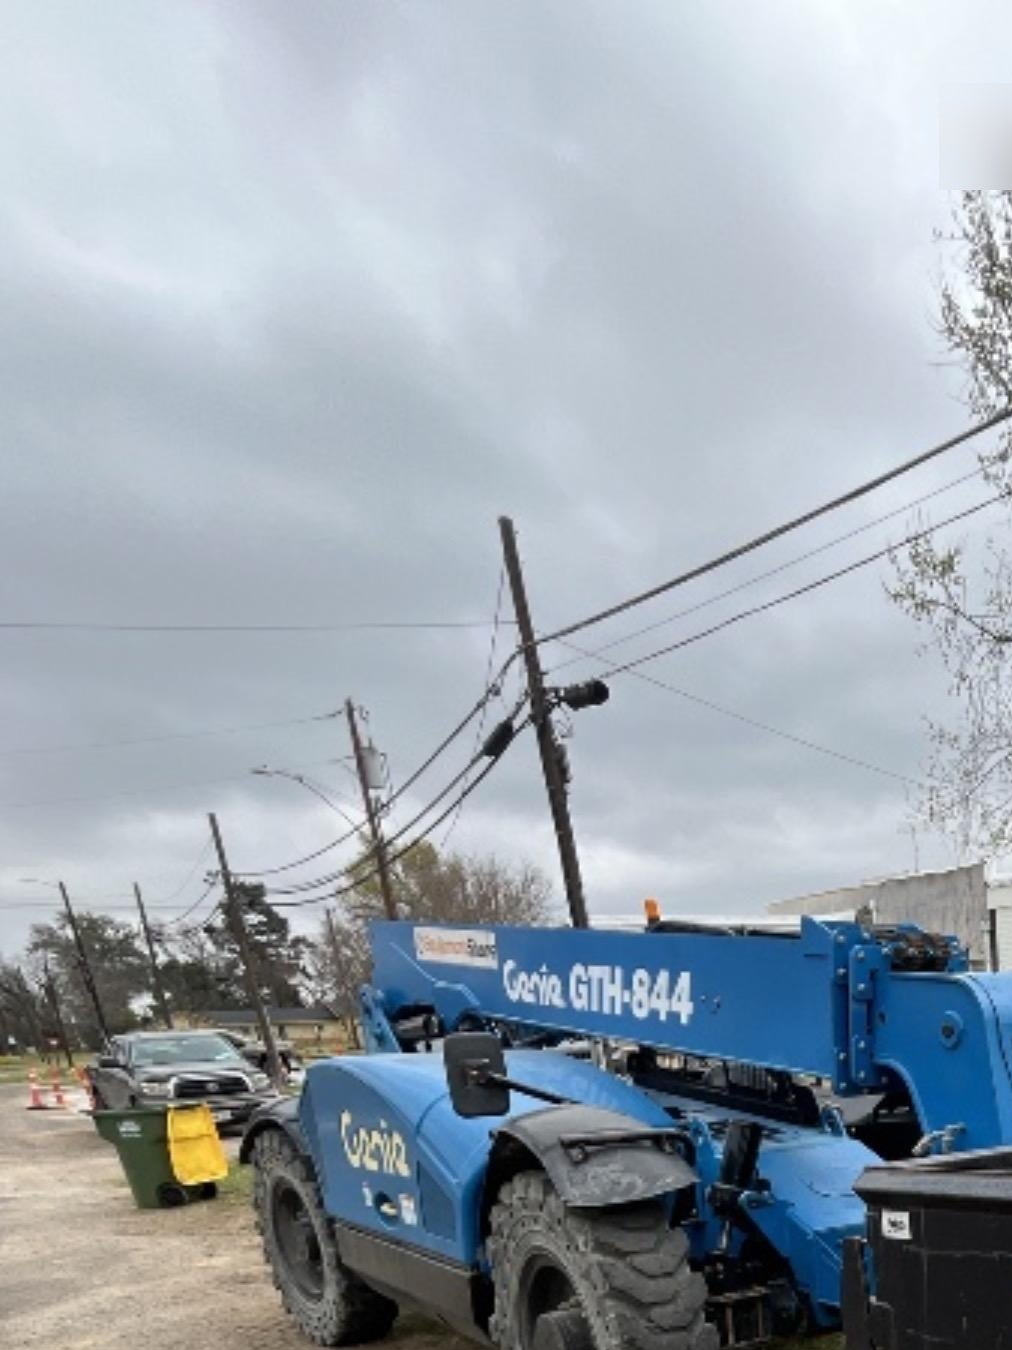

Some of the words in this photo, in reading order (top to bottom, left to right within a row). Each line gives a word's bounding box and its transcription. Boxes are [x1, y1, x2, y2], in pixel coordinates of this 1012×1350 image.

[503, 959, 567, 1008] Genie
[569, 963, 694, 1025] GTH-844
[341, 1110, 411, 1177] Genie
